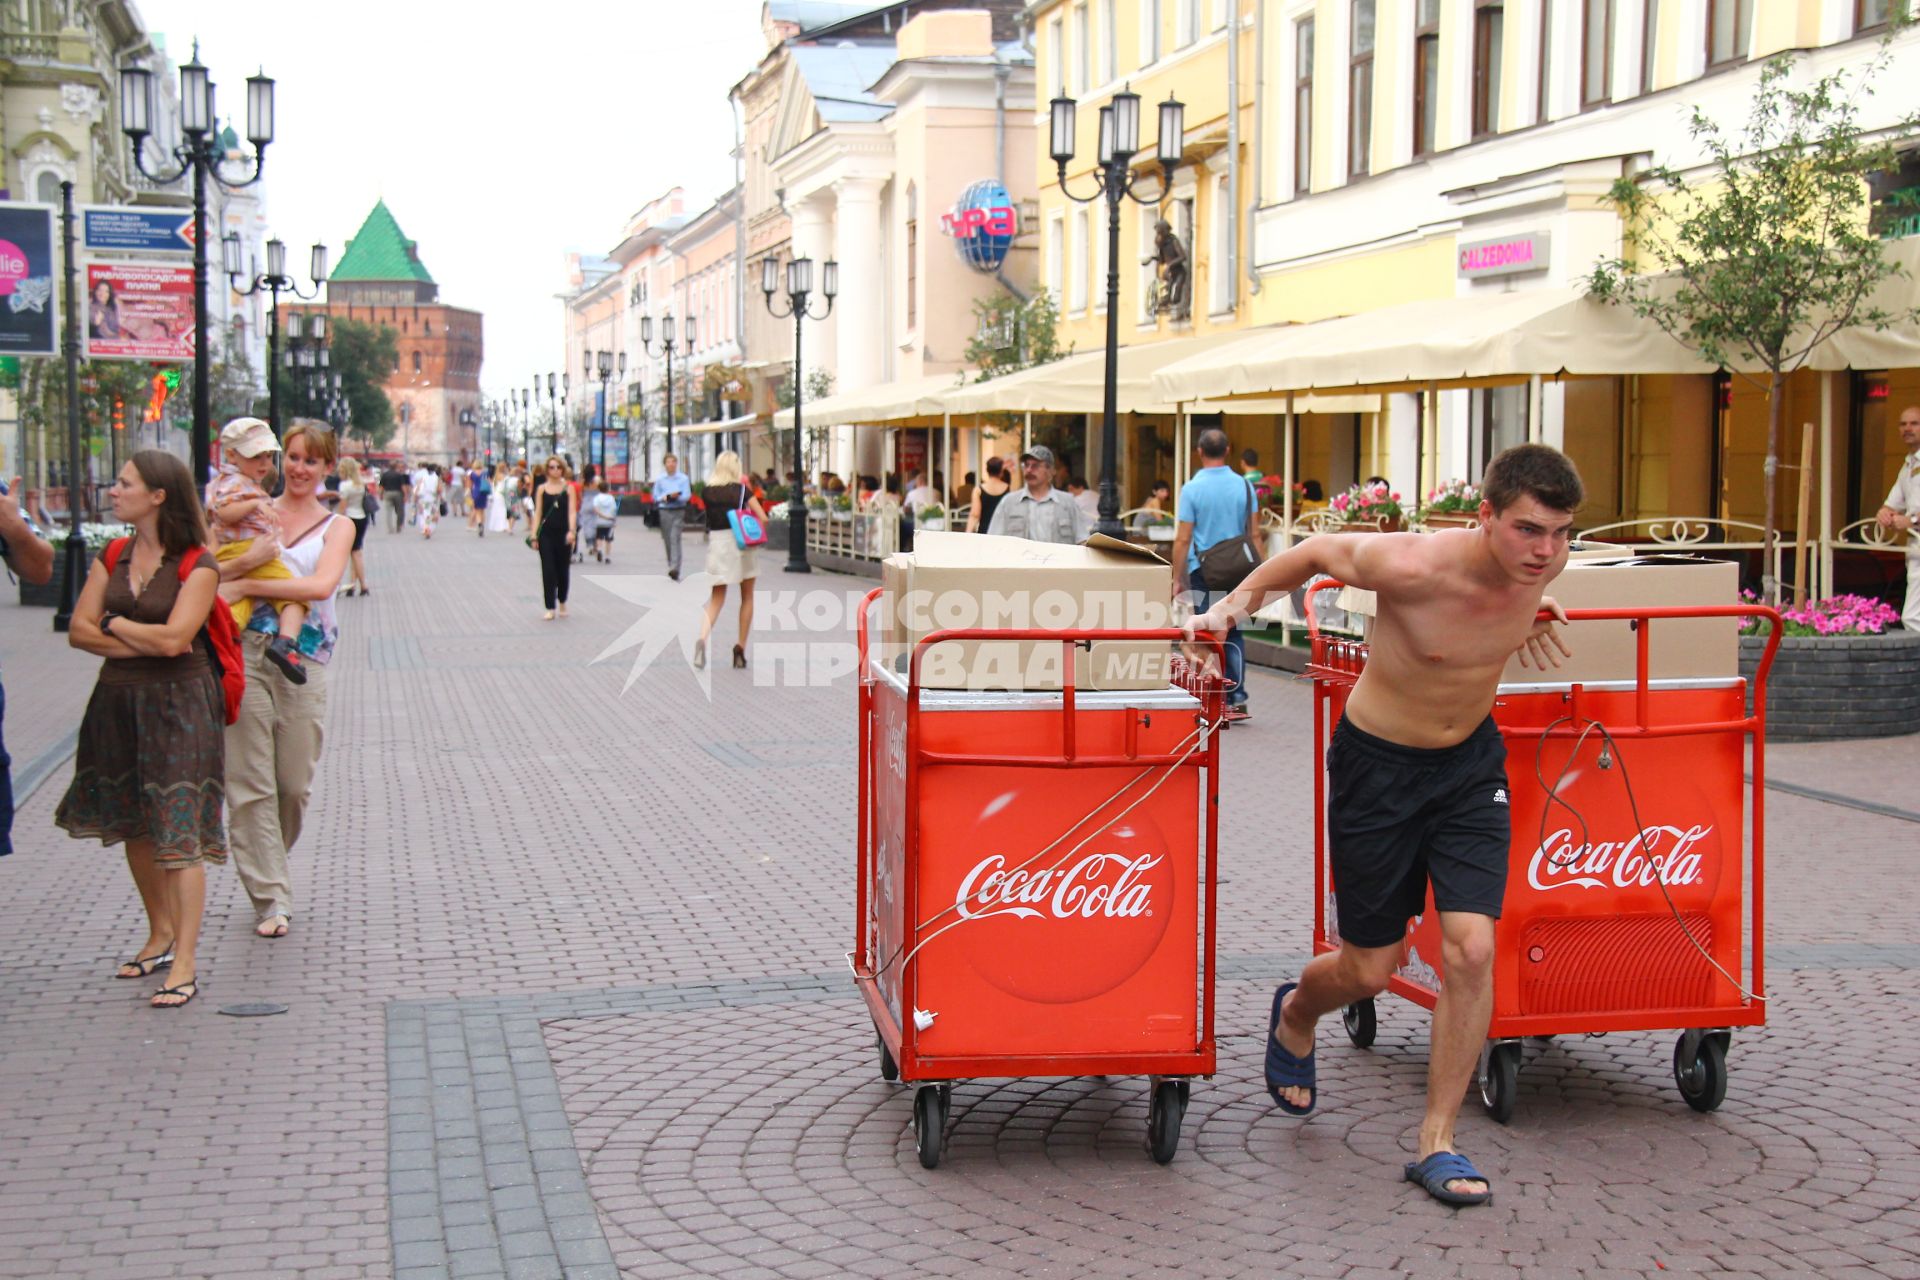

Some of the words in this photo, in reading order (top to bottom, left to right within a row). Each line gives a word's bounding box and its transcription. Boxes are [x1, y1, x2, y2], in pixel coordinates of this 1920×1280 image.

[1460, 240, 1534, 270] CALZEDONIA
[955, 853, 1165, 921] Coca-Cola
[1527, 824, 1713, 892] Coca-Cola
